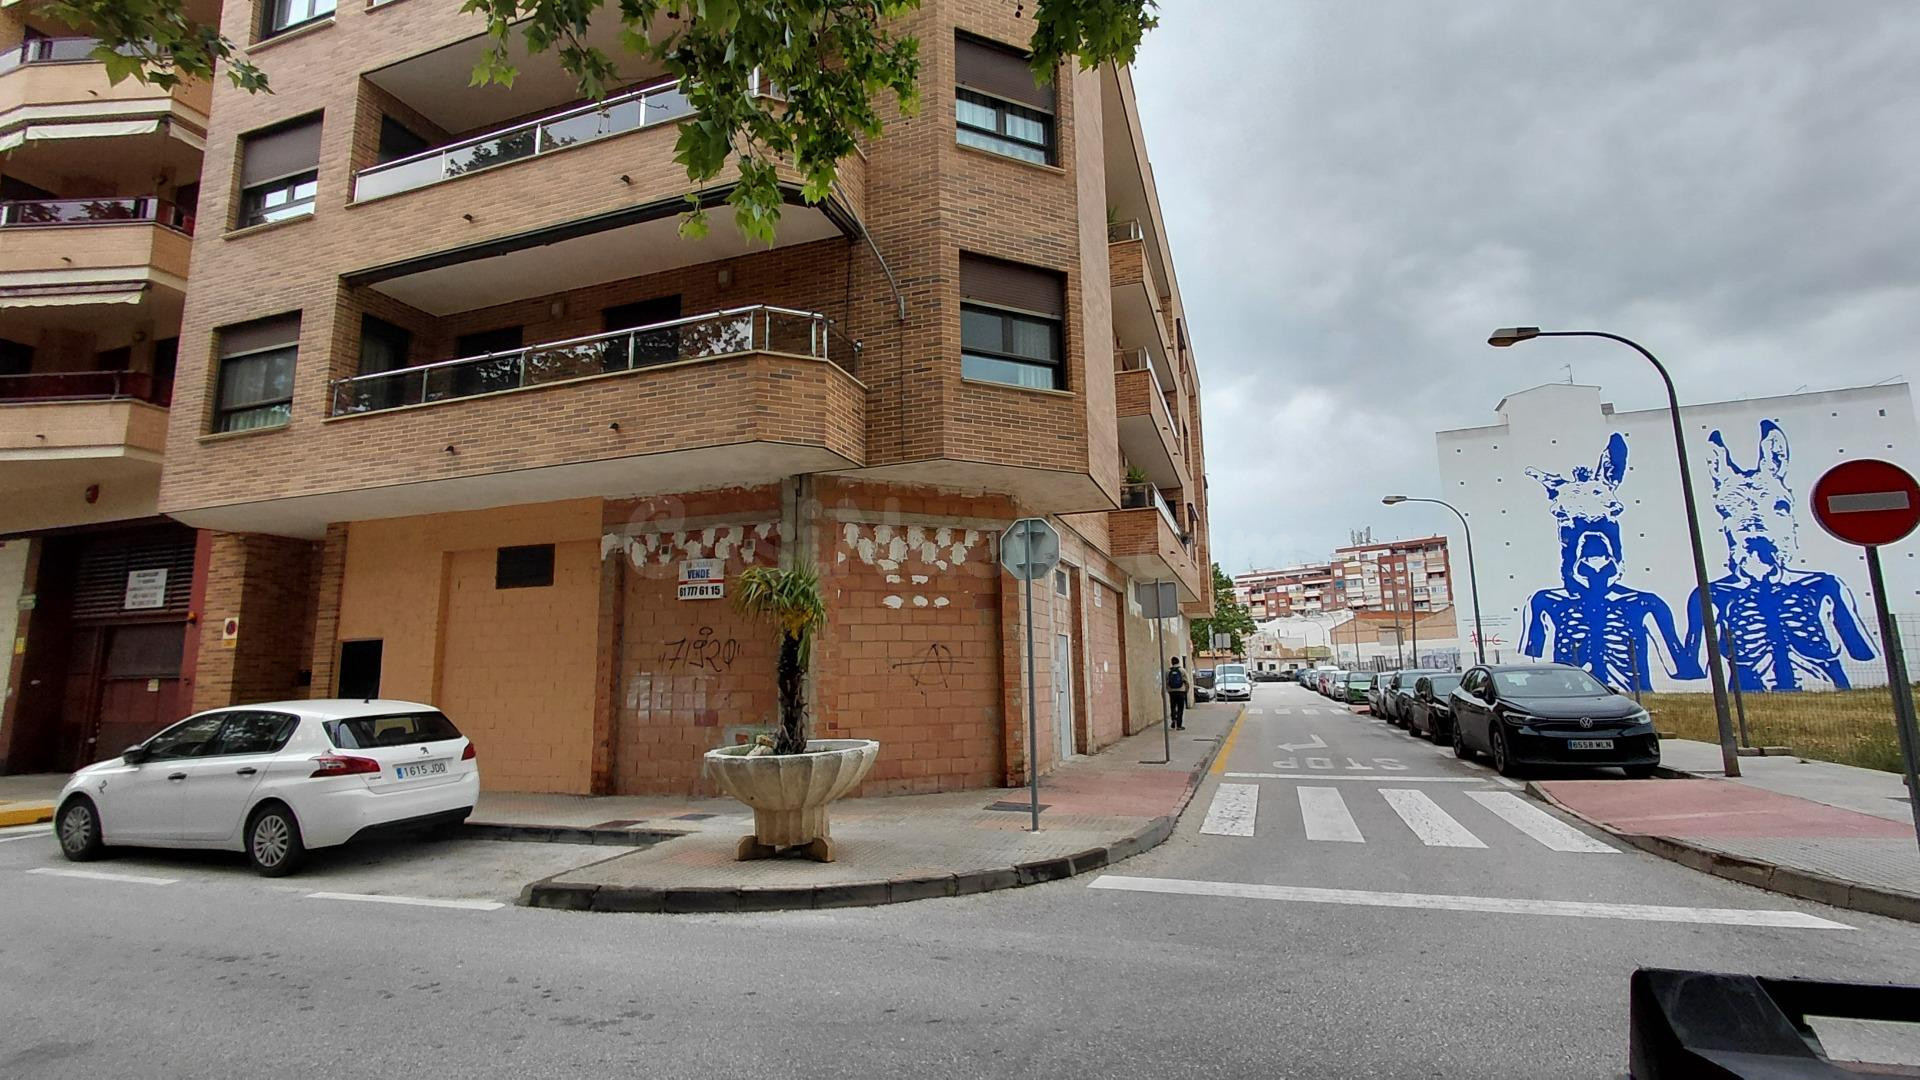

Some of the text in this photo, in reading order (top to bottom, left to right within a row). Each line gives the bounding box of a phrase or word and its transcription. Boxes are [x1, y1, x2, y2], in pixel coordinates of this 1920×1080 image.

[687, 569, 710, 579] VENDE
[710, 585, 721, 595] 15
[1272, 756, 1410, 771] STOP
[404, 764, 428, 777] 1615
